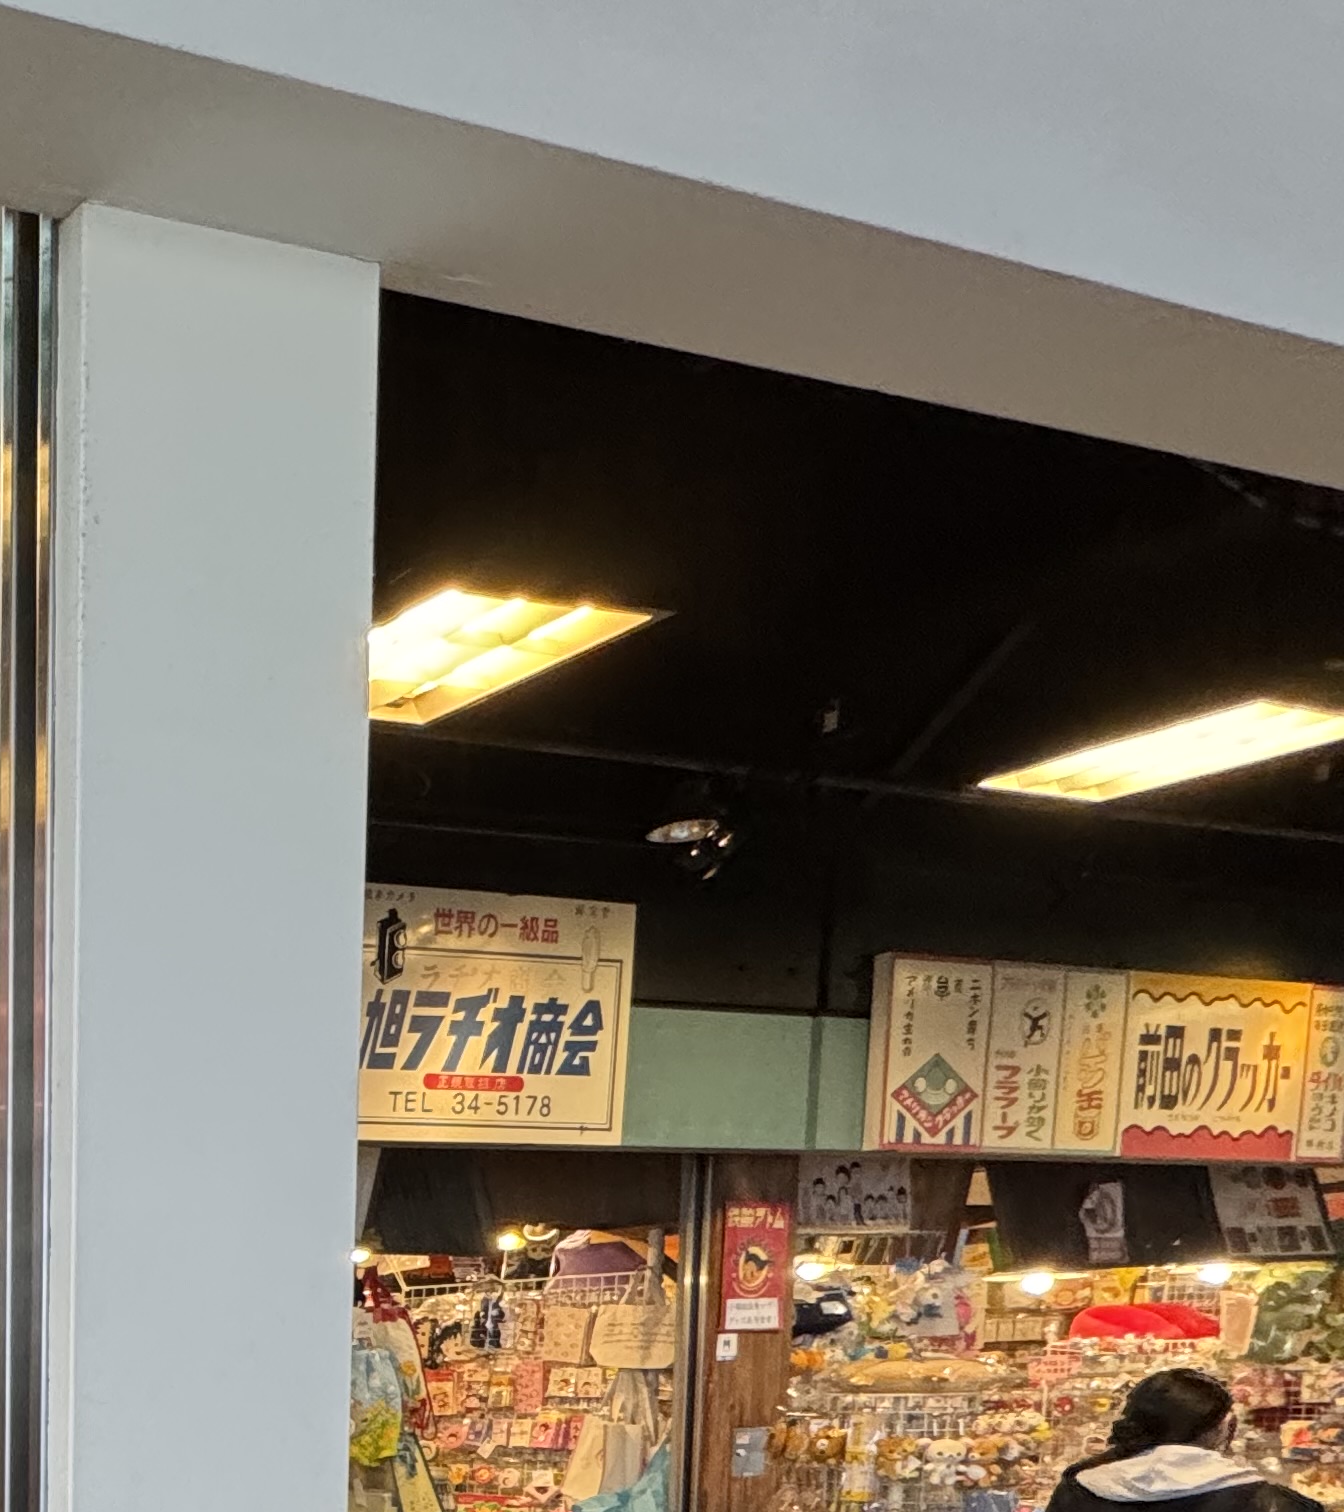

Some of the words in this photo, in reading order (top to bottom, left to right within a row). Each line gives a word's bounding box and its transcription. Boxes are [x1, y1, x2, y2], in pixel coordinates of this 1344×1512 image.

[433, 907, 561, 945] 世界の一級品
[360, 987, 604, 1077] 旭ラヂオ商会
[1133, 1022, 1292, 1114] 前田のクラッカー
[388, 1091, 433, 1113] TEL
[451, 1092, 552, 1118] 34-5178
